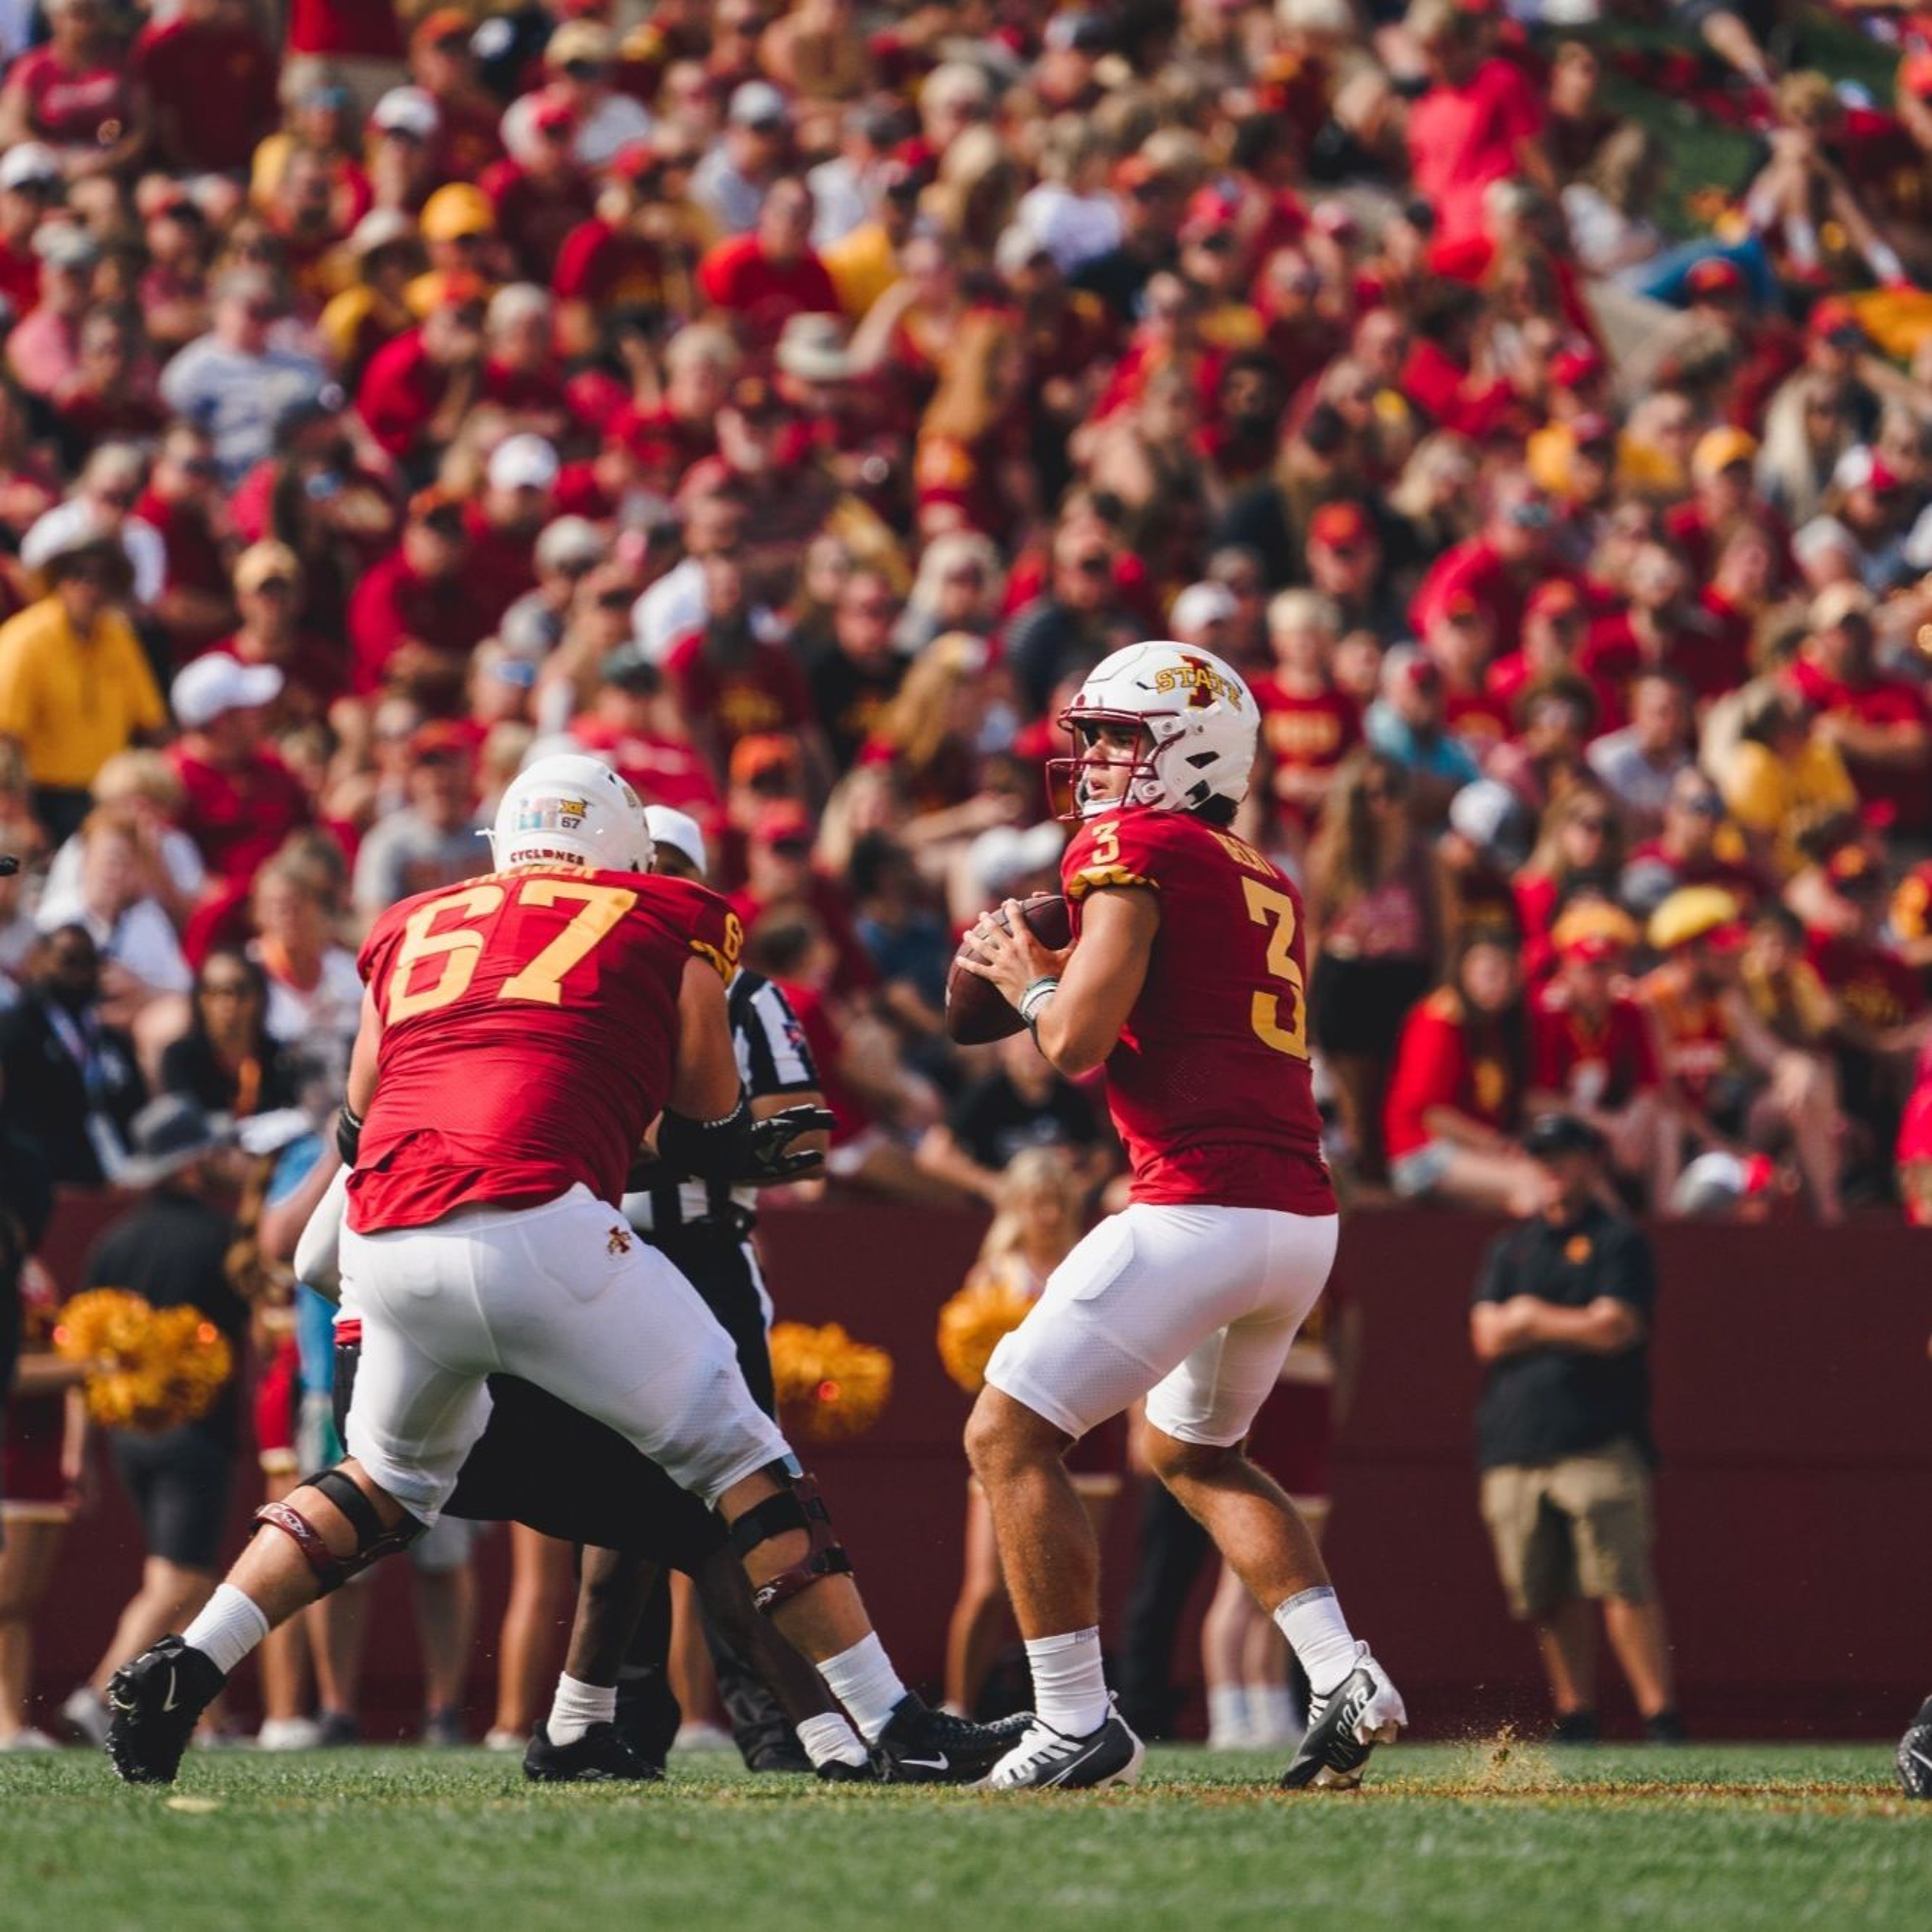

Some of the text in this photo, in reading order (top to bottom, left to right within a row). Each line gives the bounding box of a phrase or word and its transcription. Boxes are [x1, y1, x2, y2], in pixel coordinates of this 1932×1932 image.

[1155, 667, 1242, 712] STATE
[561, 816, 581, 829] 67
[1092, 820, 1120, 864] 3
[510, 848, 585, 866] CYCLONES
[387, 880, 638, 1027] 67
[723, 912, 743, 961] 6
[1241, 875, 1309, 1060] 3
